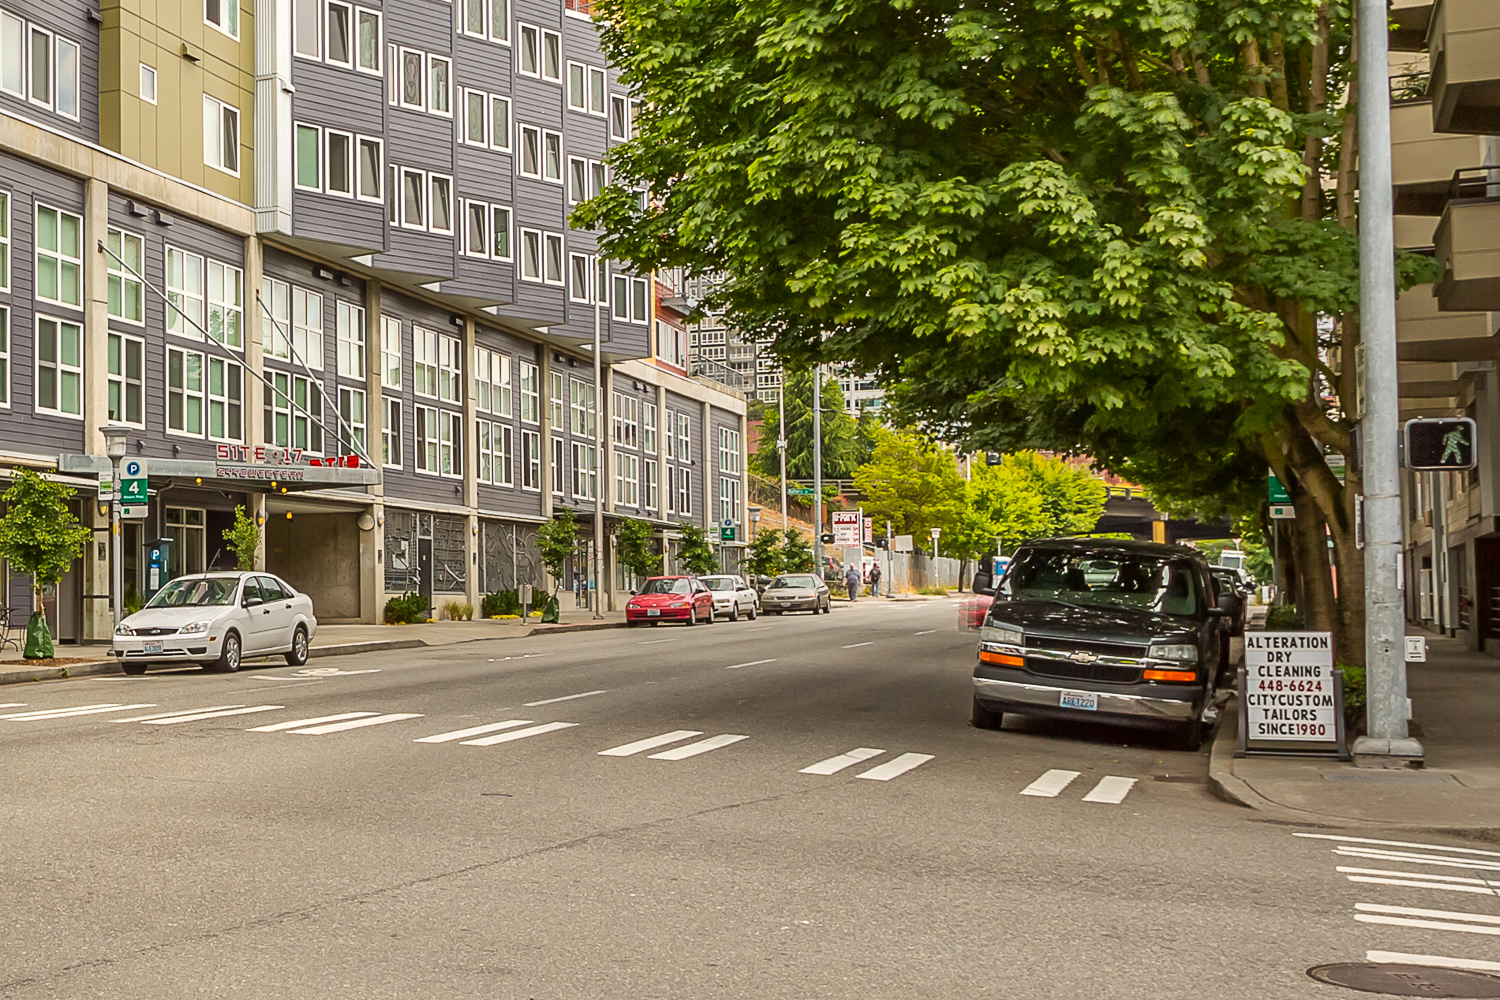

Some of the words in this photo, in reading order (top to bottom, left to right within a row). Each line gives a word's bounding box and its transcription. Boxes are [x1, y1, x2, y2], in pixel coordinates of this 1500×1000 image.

[217, 444, 266, 460] SITE
[130, 464, 138, 474] P
[128, 480, 139, 494] 4
[152, 550, 160, 560] P
[1247, 637, 1328, 648] ALTERATION
[1267, 651, 1292, 662] DRY
[1258, 666, 1321, 677] CLEANING
[1258, 680, 1322, 692] 448-6624
[1248, 694, 1333, 706] CITYCUSTOM
[1263, 709, 1317, 721] TAILORS
